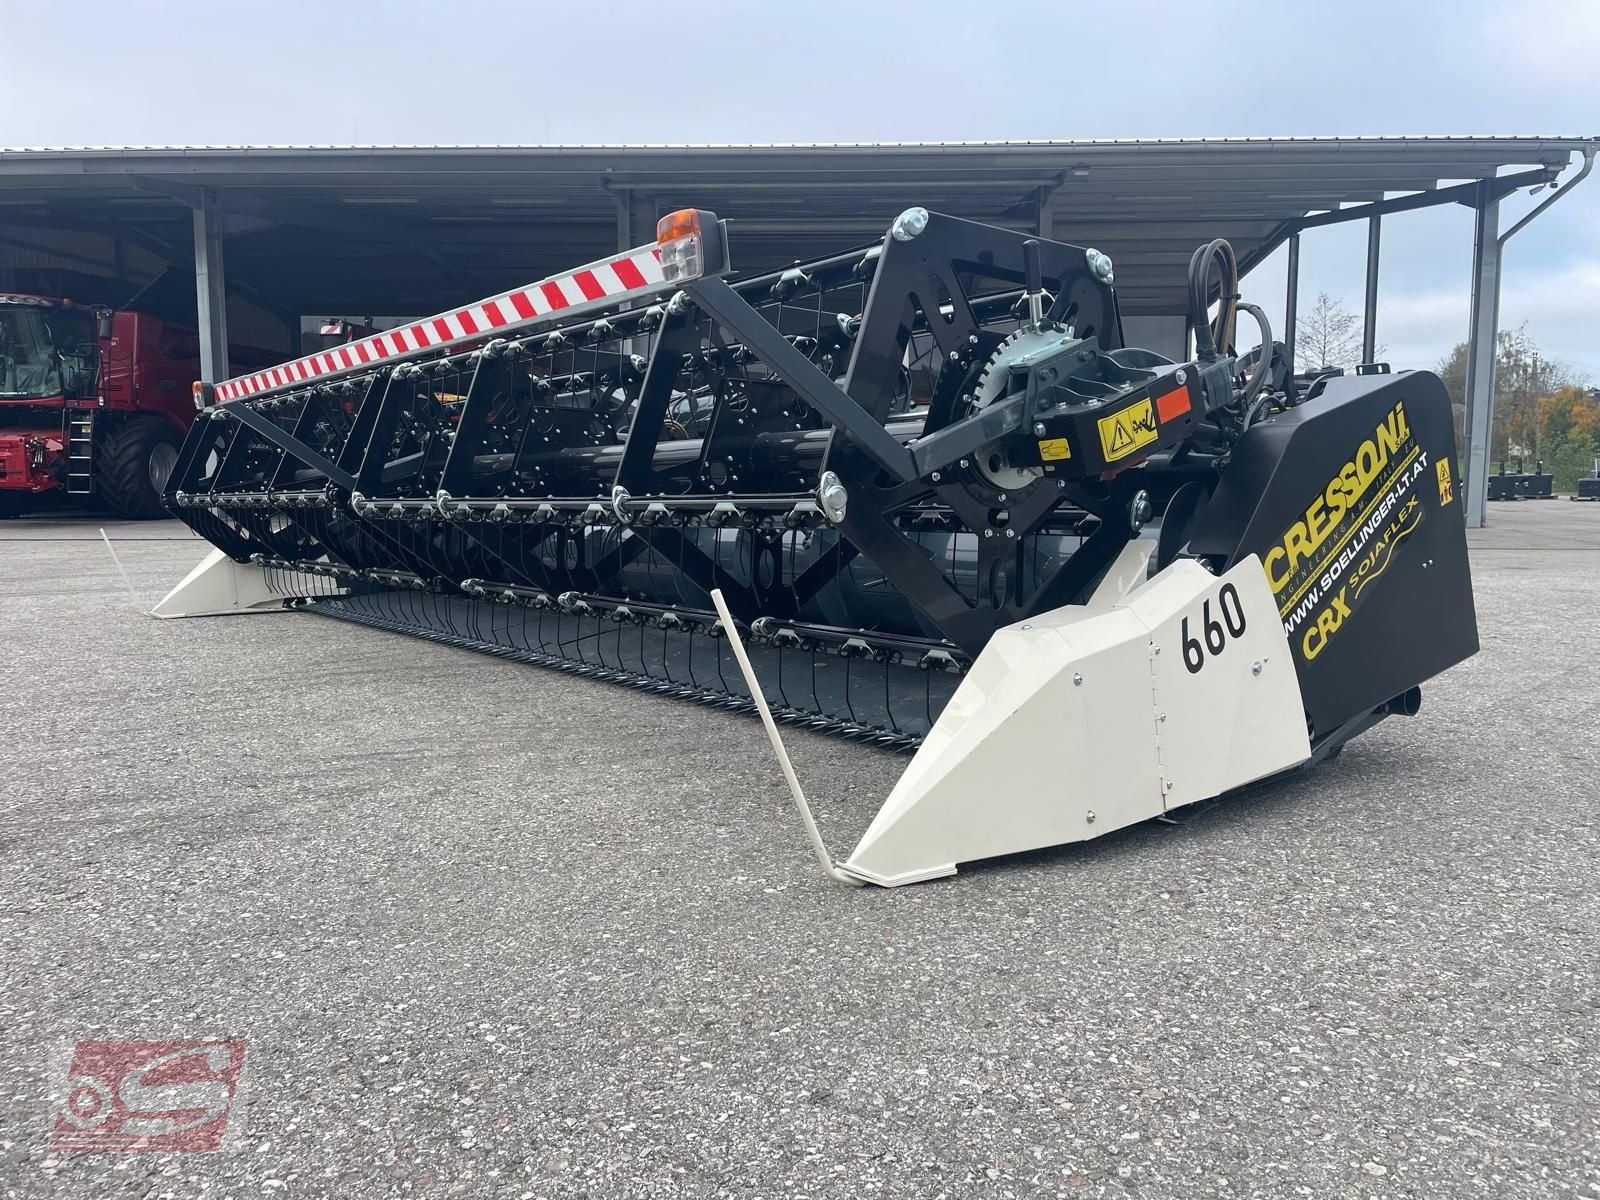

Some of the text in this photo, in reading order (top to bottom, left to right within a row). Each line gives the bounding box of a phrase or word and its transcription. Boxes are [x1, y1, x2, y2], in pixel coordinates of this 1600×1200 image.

[1280, 523, 1346, 604] NGINEERING
[1283, 451, 1428, 638] WWW.SOELLINGER-LT.AT
[1348, 493, 1419, 589] SOJAFLEX
[1181, 582, 1247, 674] 660
[1302, 585, 1352, 661] CRX
